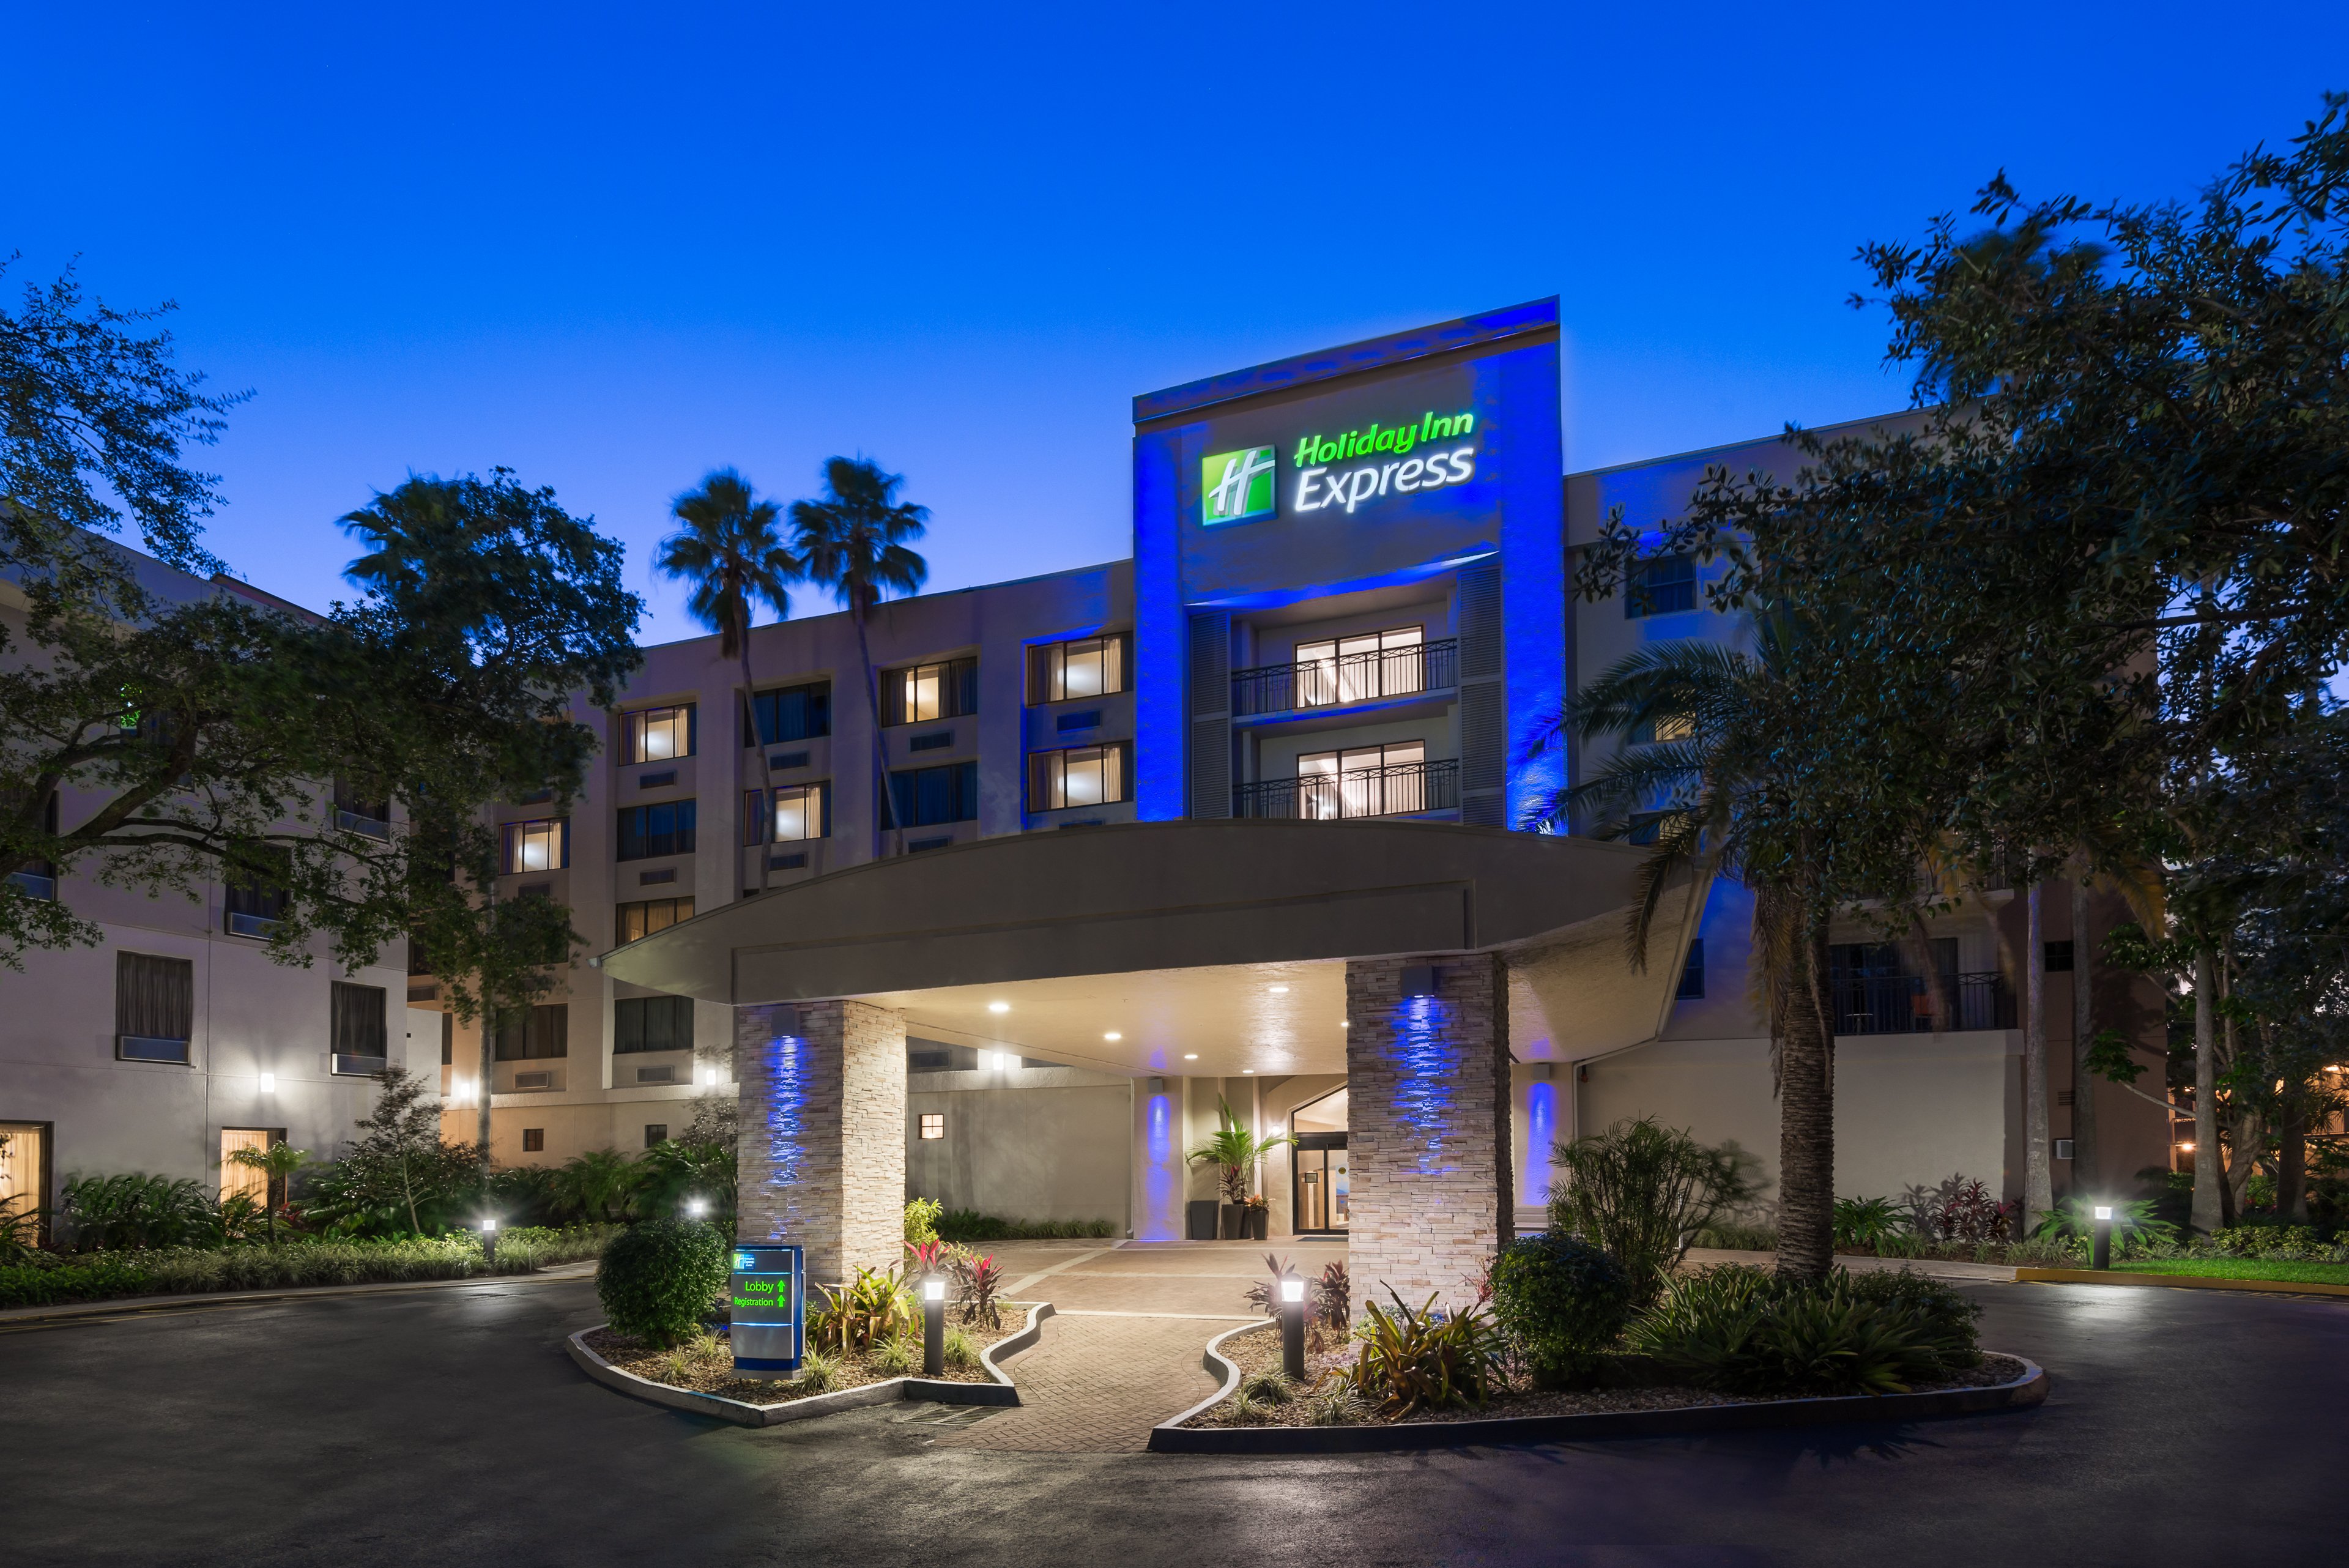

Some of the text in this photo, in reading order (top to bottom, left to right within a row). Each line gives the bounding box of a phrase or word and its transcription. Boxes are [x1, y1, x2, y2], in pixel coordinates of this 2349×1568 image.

[1294, 411, 1474, 467] Holiday Inn
[1296, 447, 1474, 513] Express
[734, 1297, 774, 1307] Registration
[745, 1281, 774, 1294] Lobby
